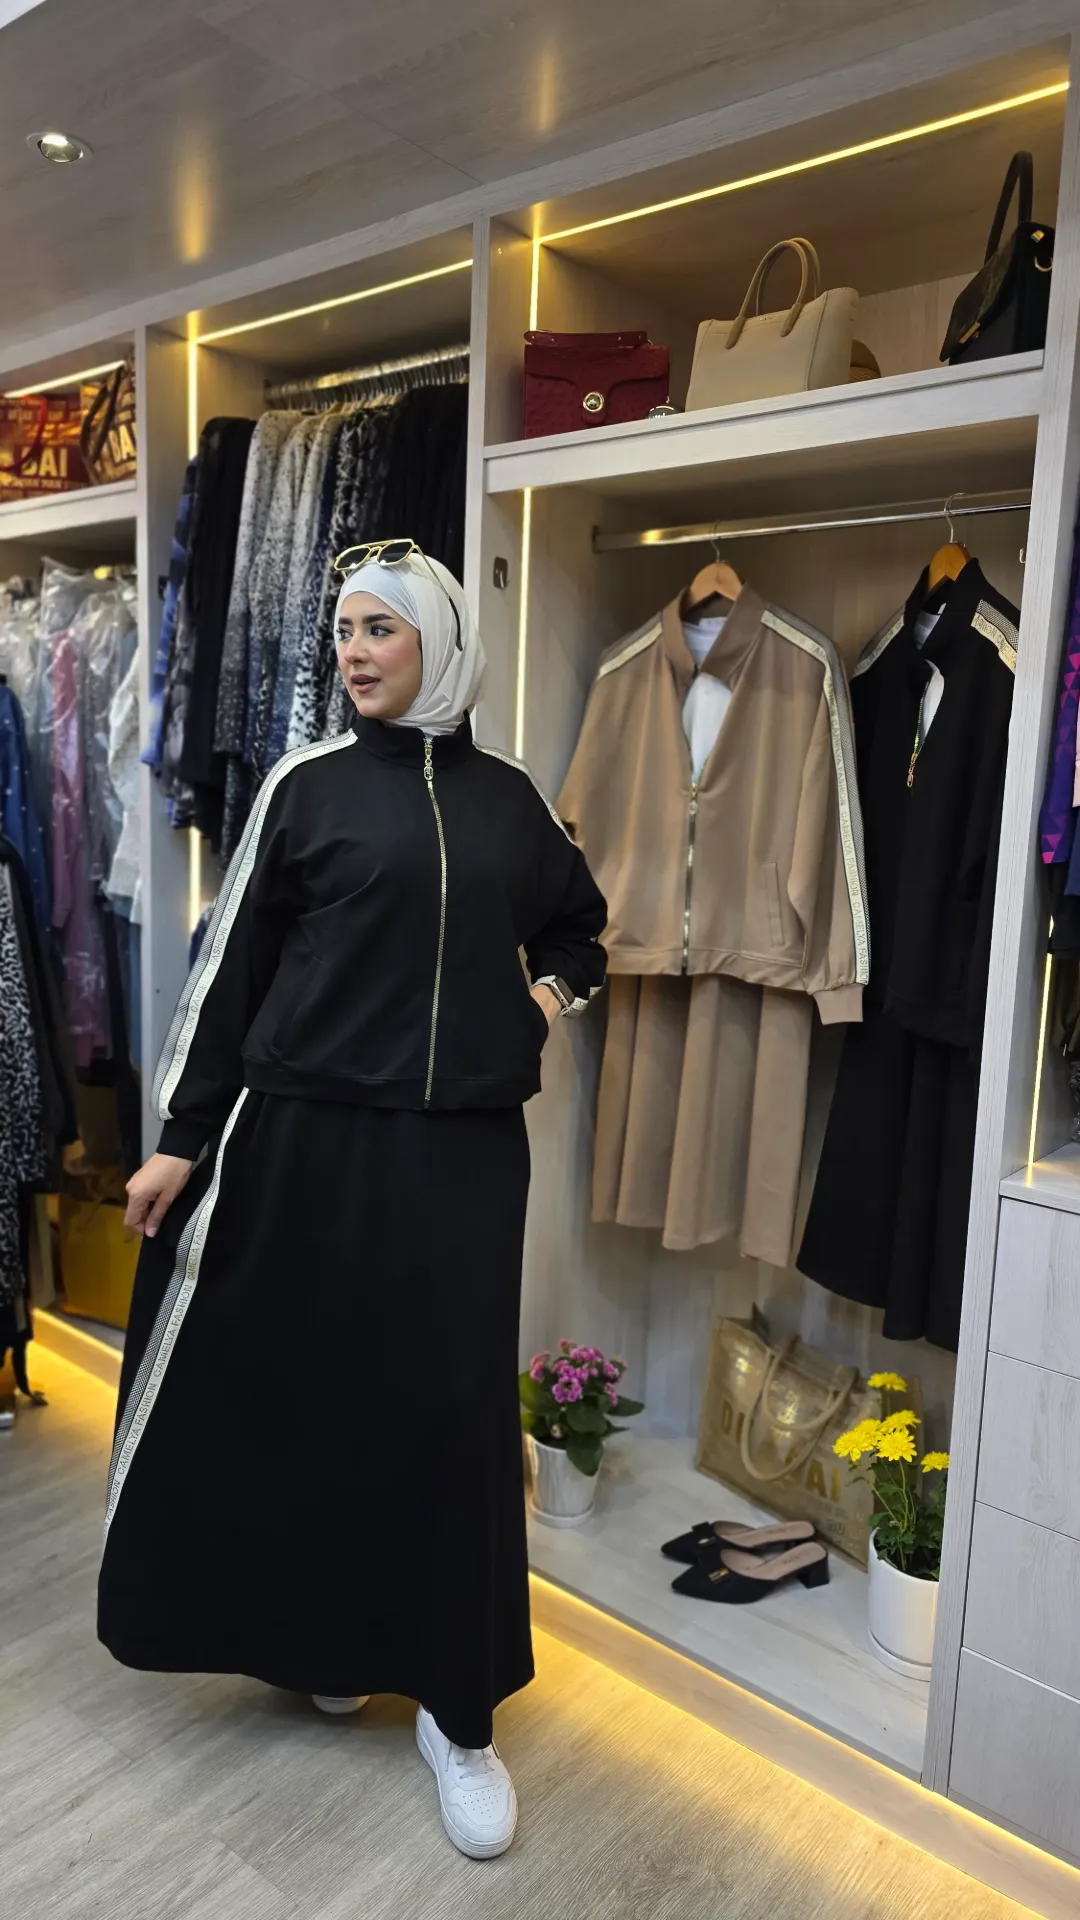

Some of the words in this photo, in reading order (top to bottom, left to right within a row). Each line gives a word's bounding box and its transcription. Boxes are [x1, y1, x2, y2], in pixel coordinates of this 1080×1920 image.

[175, 1015, 196, 1057] FASHION
[190, 967, 216, 1013] CAMELA
[209, 926, 228, 967] FASHION
[224, 875, 247, 922] CAMELYA
[241, 832, 260, 874] FASHION
[852, 901, 866, 946] CAMELYA
[193, 1205, 211, 1246] FASHION
[187, 1248, 200, 1281] CAMELYA
[171, 1284, 193, 1326] FASHION
[153, 1328, 177, 1378] CAMELYA
[134, 1382, 157, 1426] FASHION
[118, 1428, 141, 1475] CAMELYA
